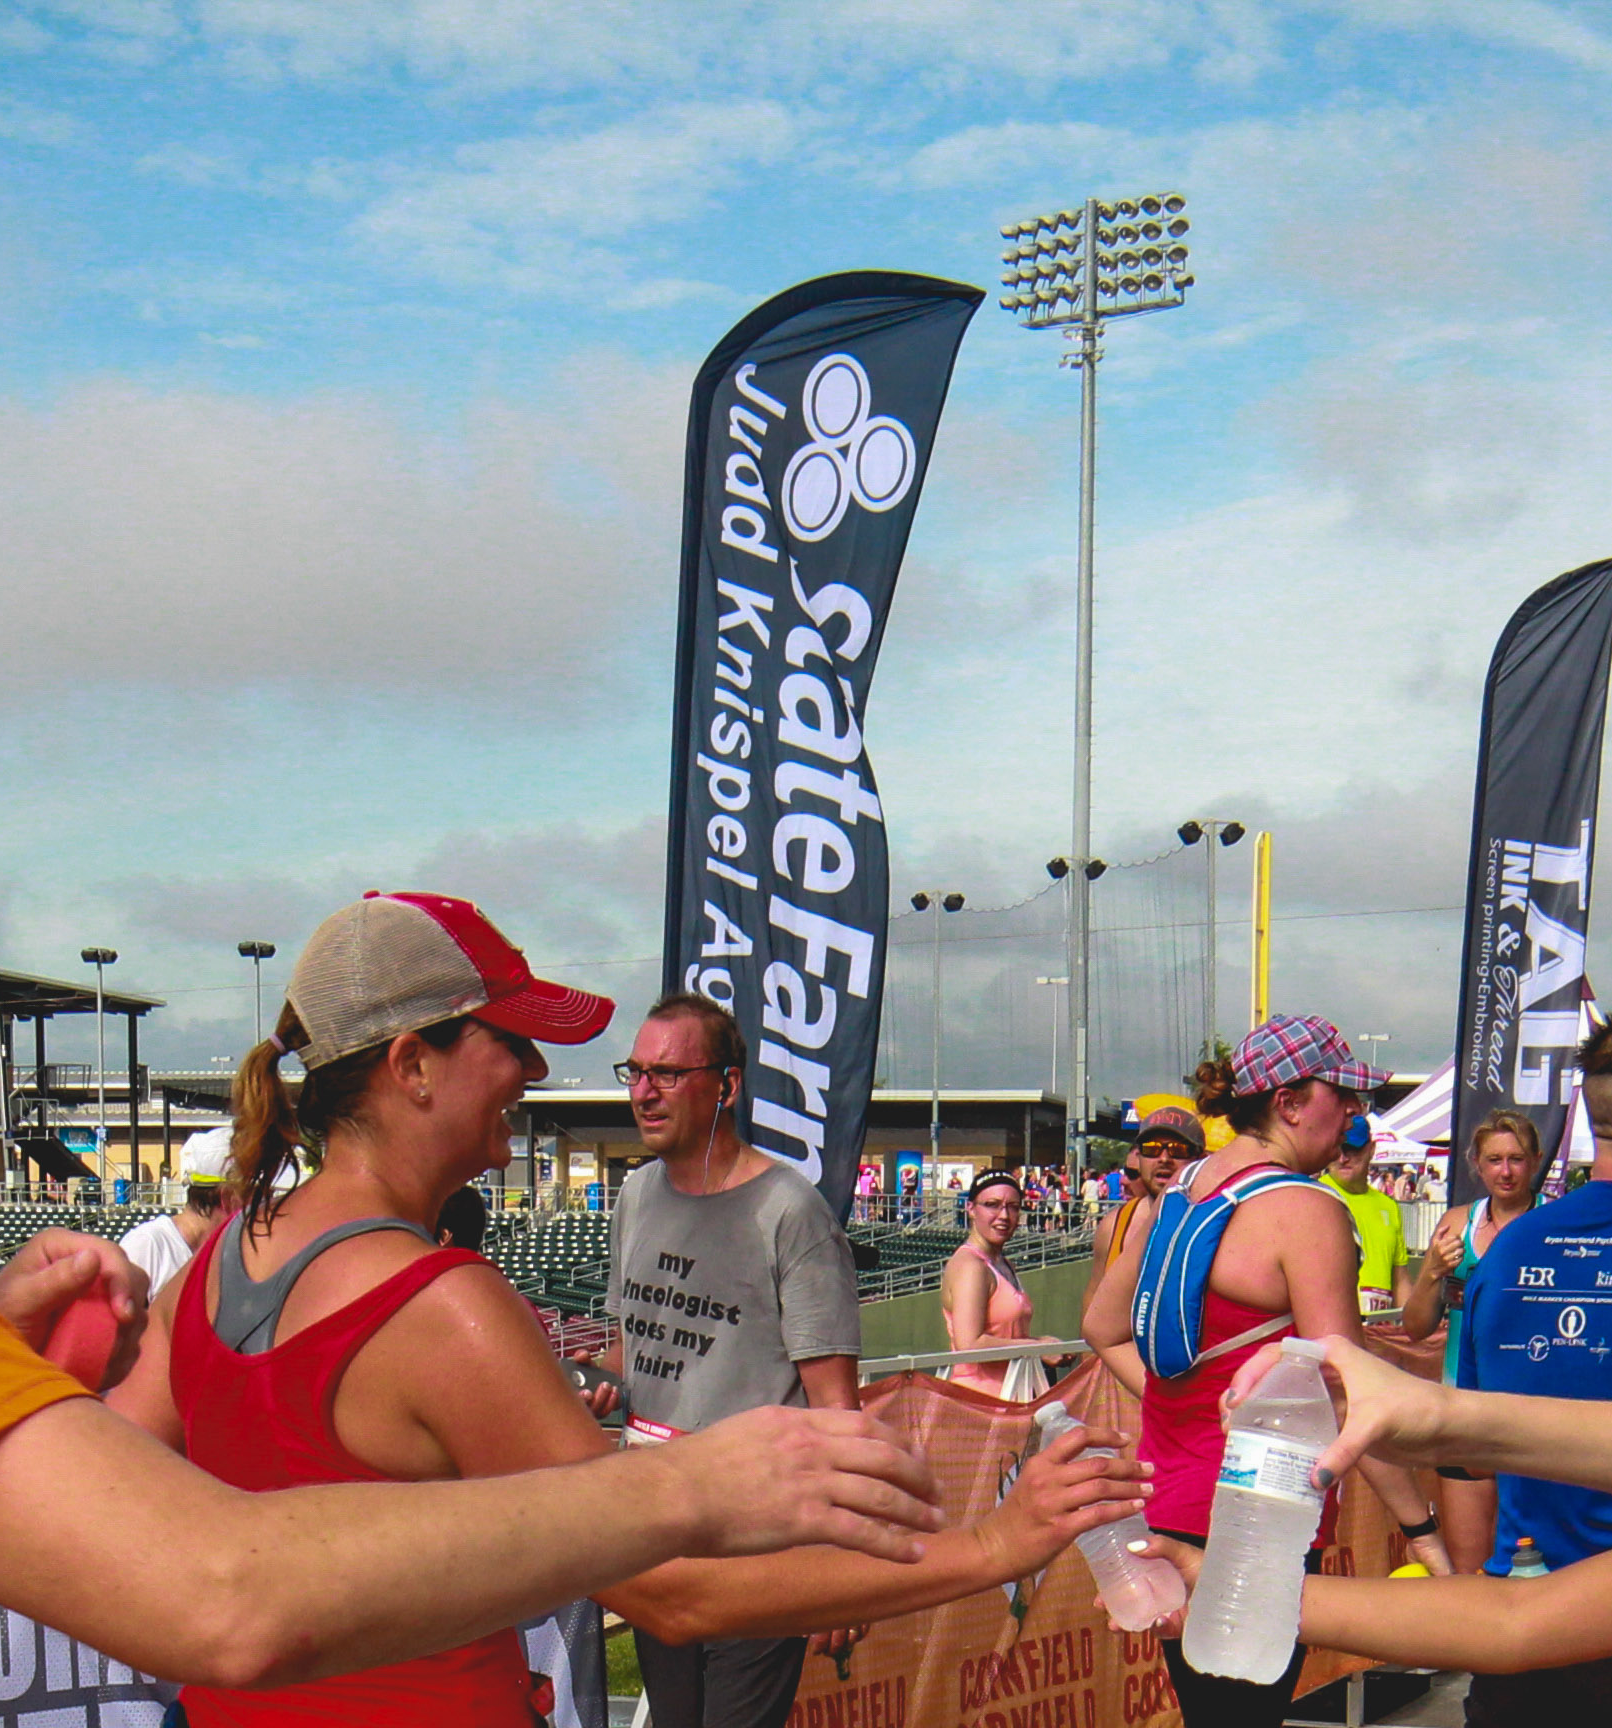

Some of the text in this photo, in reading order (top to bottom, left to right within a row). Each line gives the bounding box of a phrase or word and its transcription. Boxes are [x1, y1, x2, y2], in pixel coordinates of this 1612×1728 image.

[685, 362, 787, 1016] Judd Knispel Ag
[1486, 837, 1501, 899] Screen
[1487, 839, 1533, 1093] INK & Thread
[657, 1250, 697, 1280] my
[1517, 1266, 1556, 1287] HDR
[624, 1313, 716, 1358] does my
[633, 1350, 685, 1383] hair!
[960, 1627, 1094, 1714] CORNFIELD
